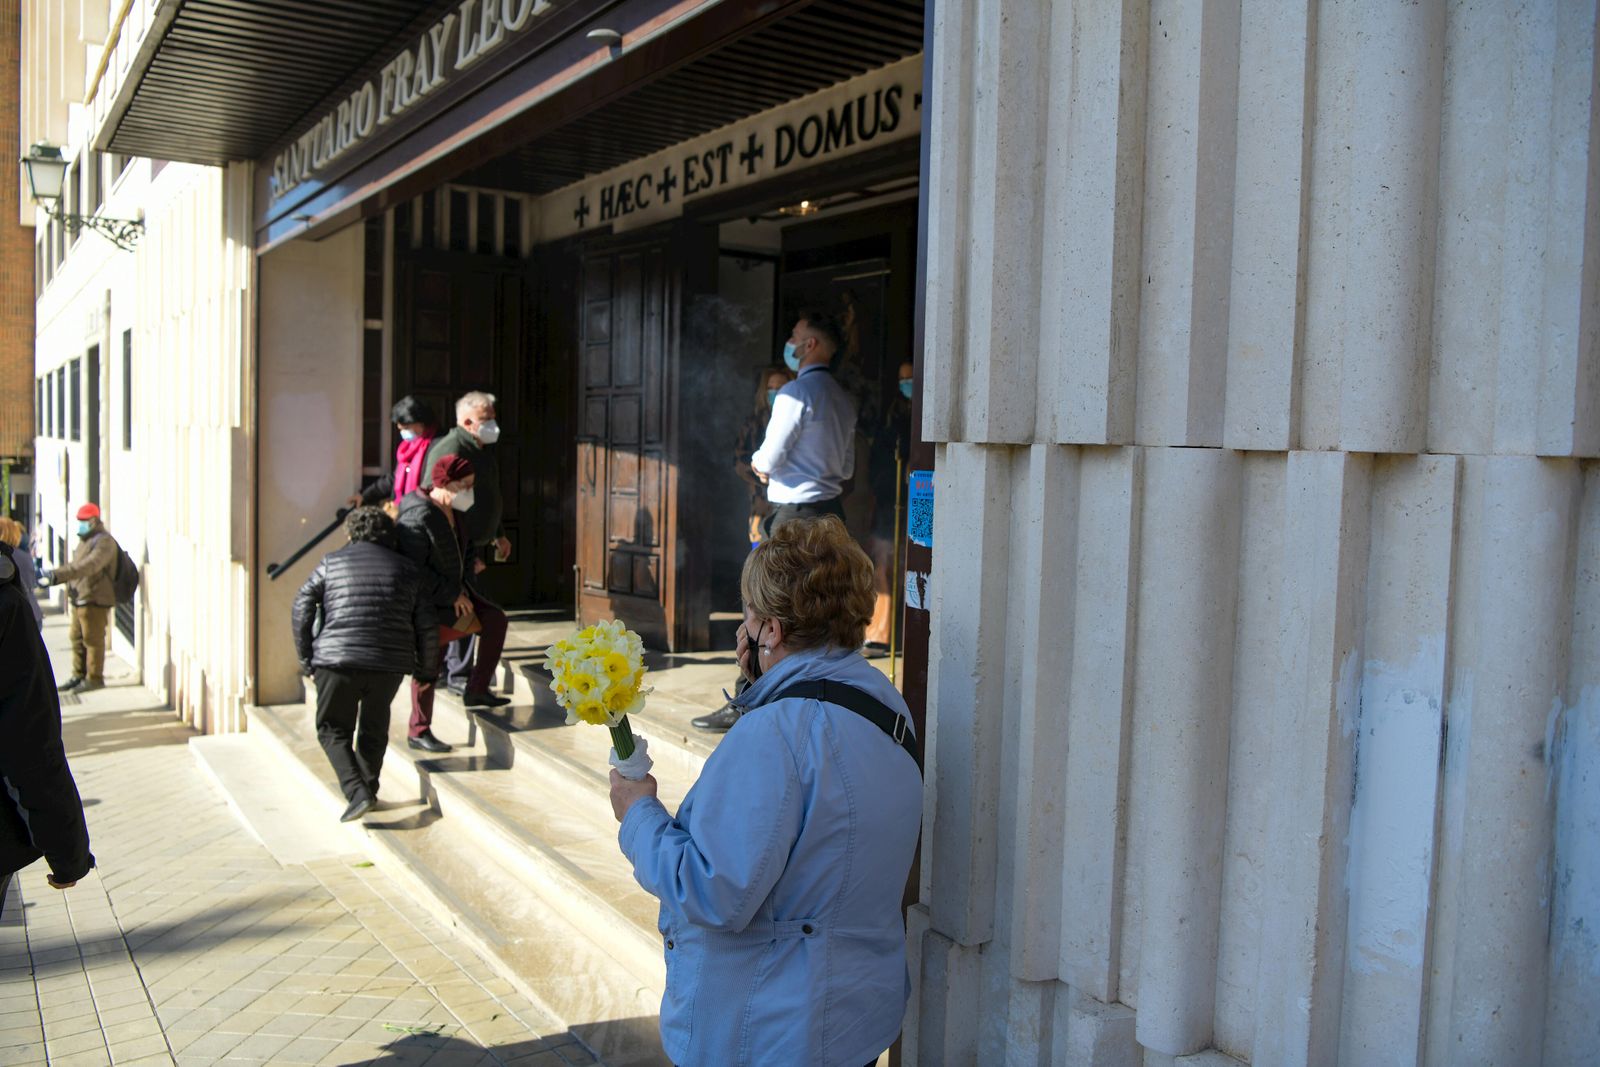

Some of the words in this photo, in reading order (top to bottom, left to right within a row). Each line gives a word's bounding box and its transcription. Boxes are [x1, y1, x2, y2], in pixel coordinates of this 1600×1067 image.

[270, 81, 377, 198] SANTUARIO
[377, 13, 456, 125] FRAY
[683, 141, 733, 197] EST
[774, 83, 904, 170] DOMUS
